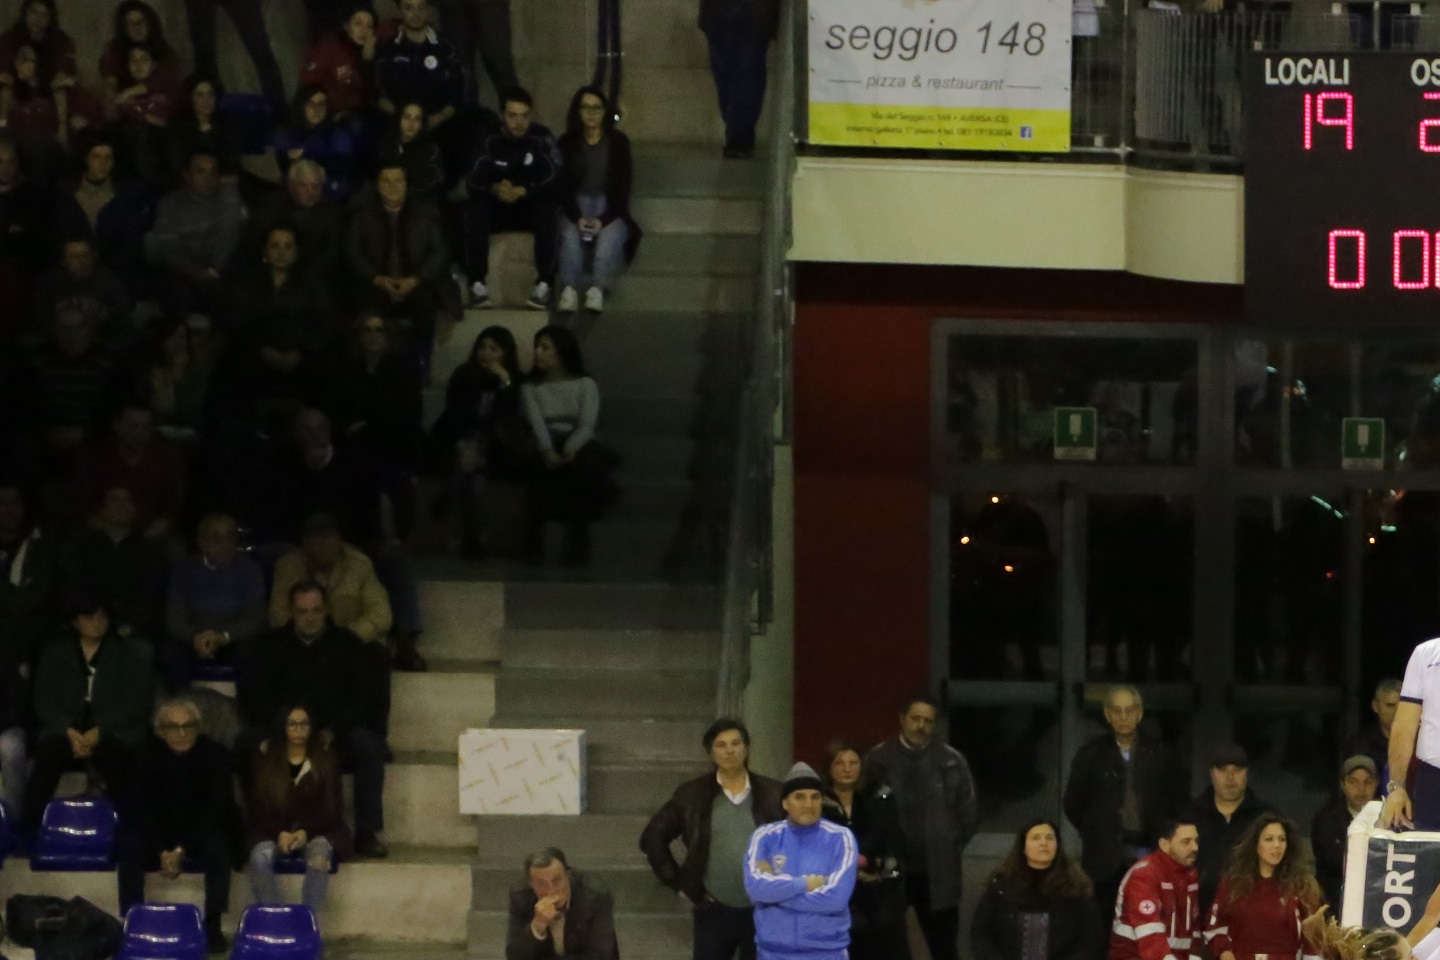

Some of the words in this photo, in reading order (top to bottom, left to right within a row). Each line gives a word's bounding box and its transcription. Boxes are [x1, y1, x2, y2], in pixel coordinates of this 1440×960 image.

[825, 18, 958, 61] seggio
[976, 20, 1047, 56] 148
[866, 75, 906, 89] pizza
[911, 77, 922, 88] &
[927, 76, 1004, 91] restaurant
[1265, 58, 1350, 85] LOCALI
[1303, 92, 1354, 151] 19
[1328, 229, 1365, 289] 0
[1382, 844, 1416, 928] ORT
